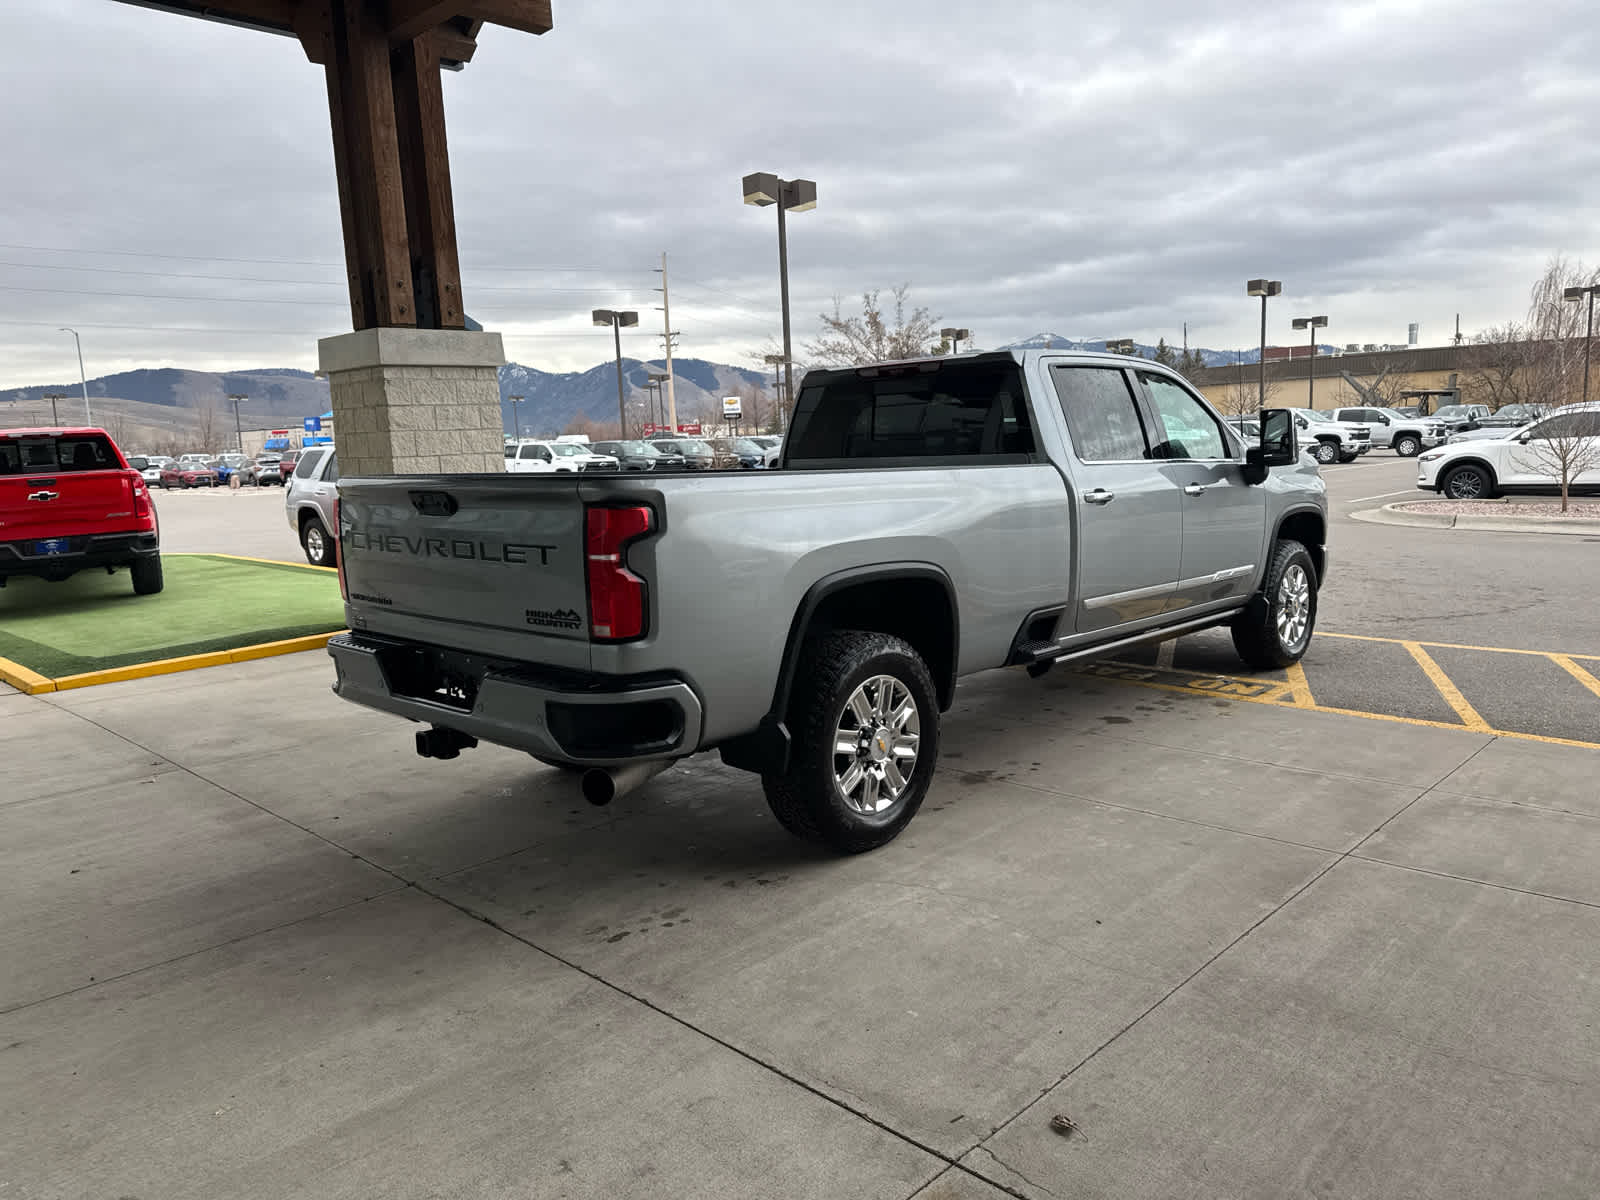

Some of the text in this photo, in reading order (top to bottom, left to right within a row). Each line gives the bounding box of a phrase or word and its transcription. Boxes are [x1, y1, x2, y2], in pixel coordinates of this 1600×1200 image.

[351, 530, 559, 565] CHEVROLET
[526, 609, 553, 619] HIGH
[526, 617, 580, 630] COUNTRY
